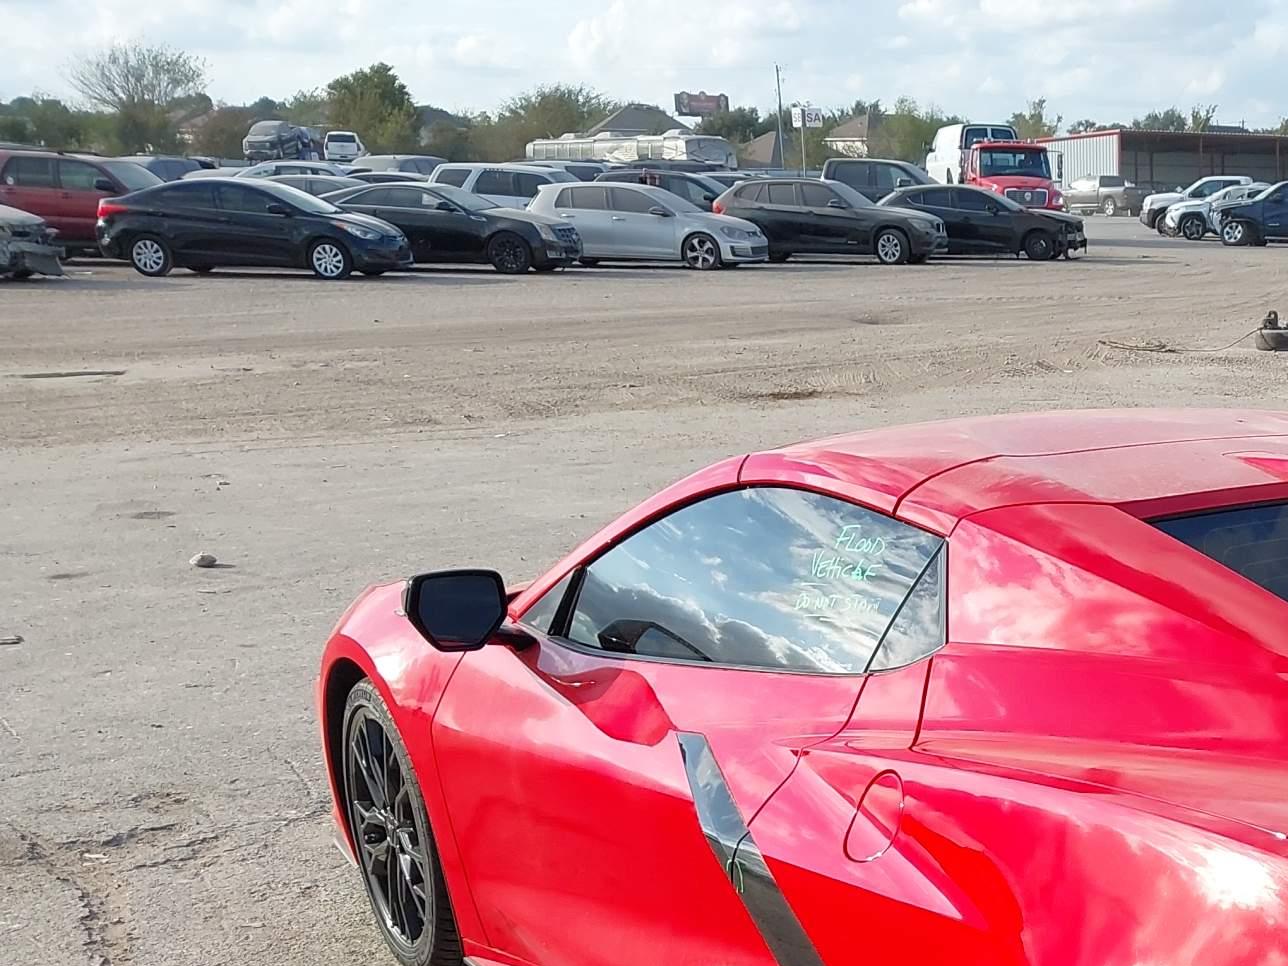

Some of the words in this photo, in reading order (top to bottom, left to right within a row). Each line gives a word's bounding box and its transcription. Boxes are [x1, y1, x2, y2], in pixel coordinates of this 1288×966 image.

[835, 525, 885, 556] FLOOD
[794, 592, 810, 610] DO
[815, 594, 842, 610] NOT
